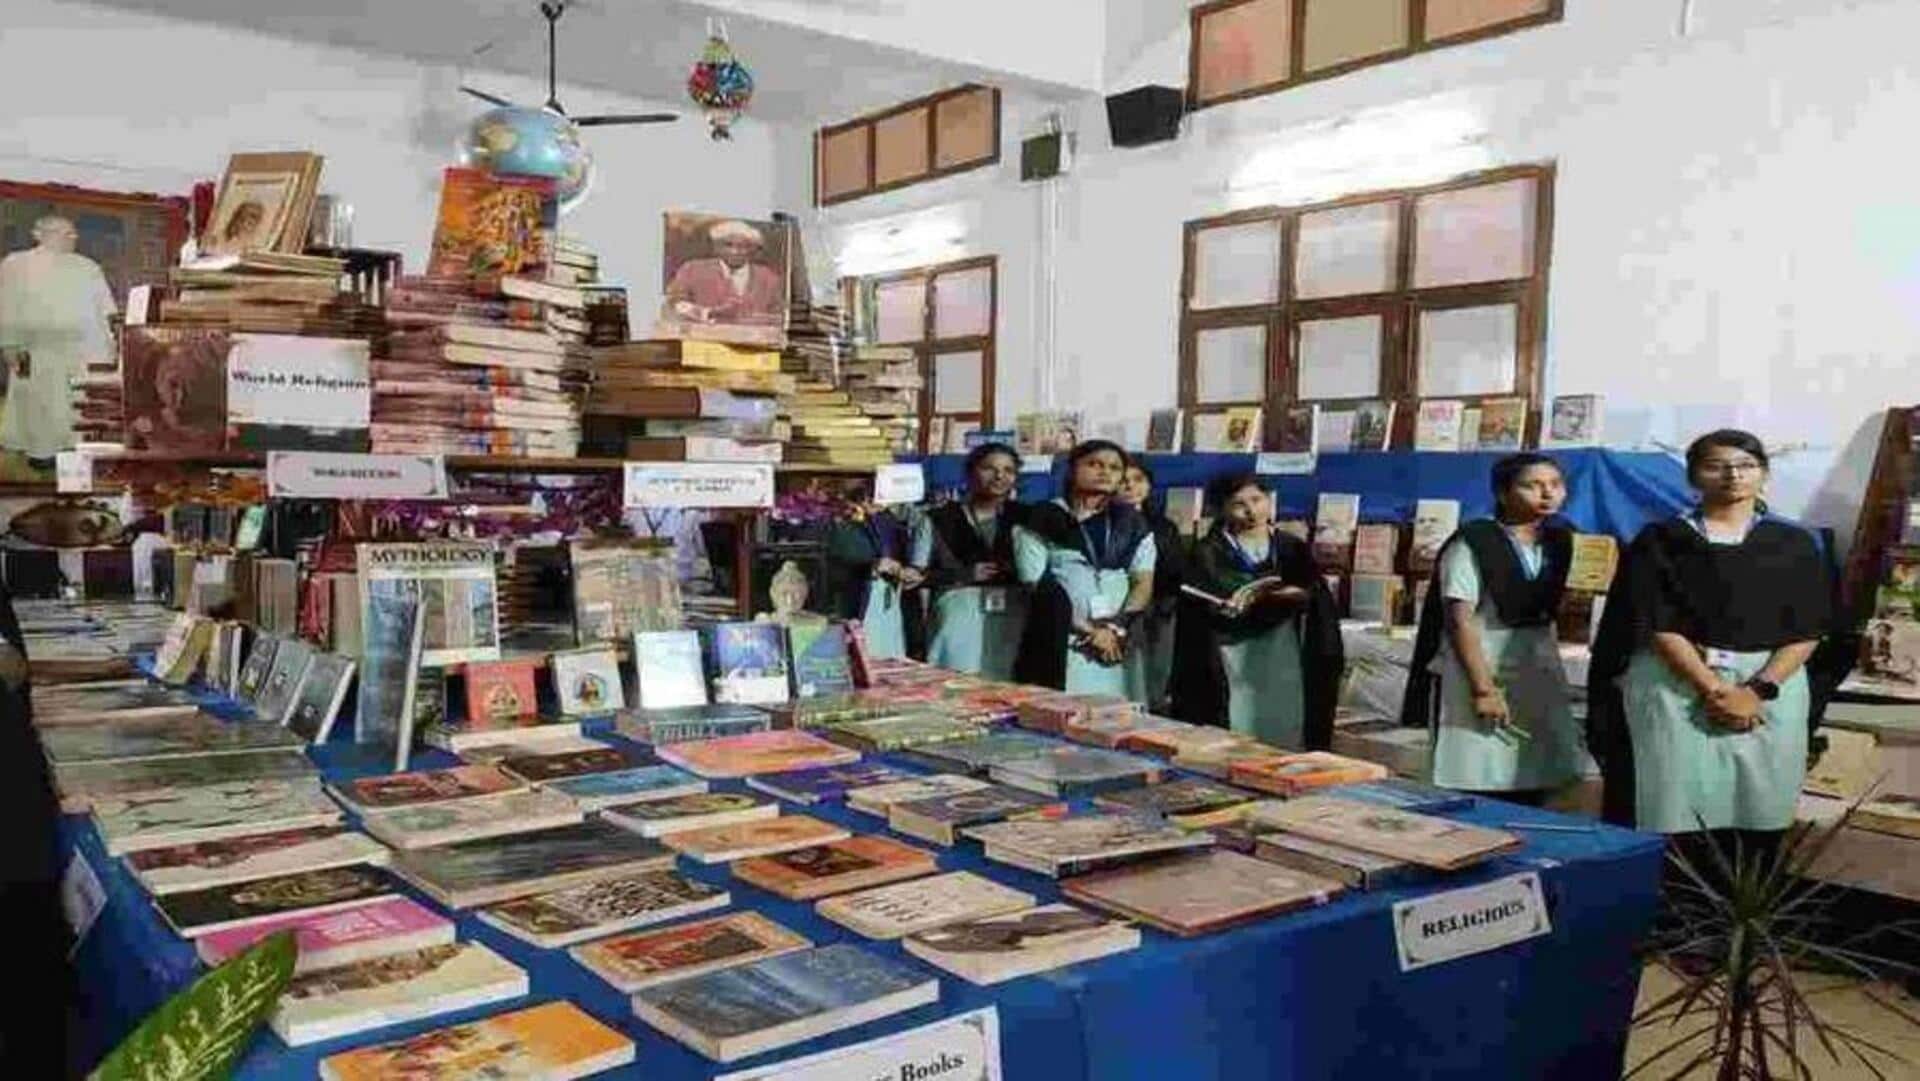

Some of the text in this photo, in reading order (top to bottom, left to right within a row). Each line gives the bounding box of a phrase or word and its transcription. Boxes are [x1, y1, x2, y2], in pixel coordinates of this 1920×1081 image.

[231, 370, 287, 385] World
[371, 547, 488, 563] MYTHOLOGY
[1421, 900, 1527, 938] RELIGIOUS
[900, 1052, 965, 1081] Books
